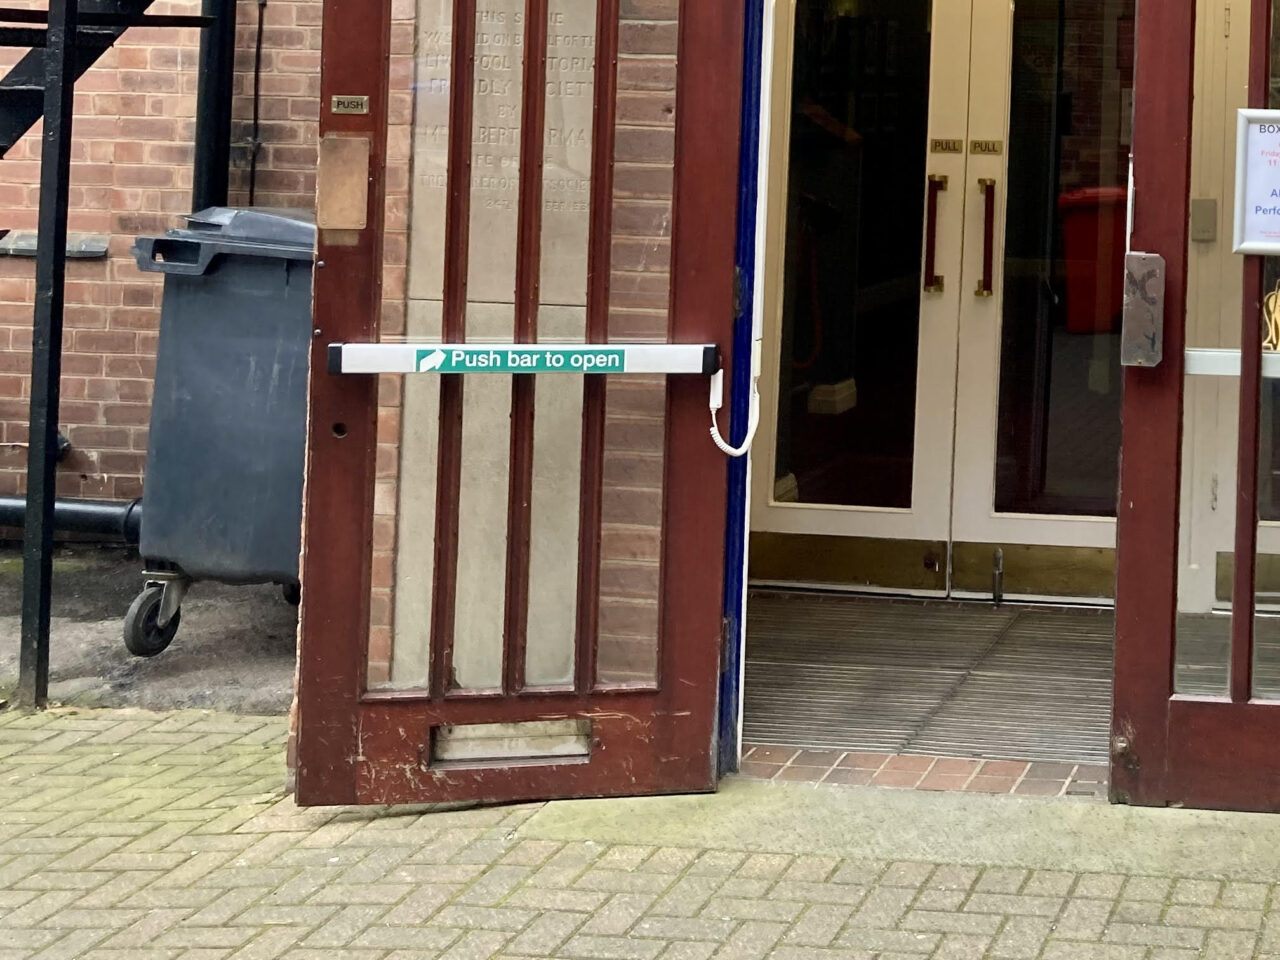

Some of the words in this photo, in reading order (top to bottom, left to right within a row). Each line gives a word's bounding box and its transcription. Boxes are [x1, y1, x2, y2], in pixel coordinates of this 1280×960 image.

[337, 99, 364, 110] PUSH
[934, 142, 958, 151] PULL
[974, 142, 998, 152] PULL
[451, 350, 500, 367] Push
[508, 351, 540, 367] bar
[545, 353, 564, 367] to
[573, 352, 619, 371] open
